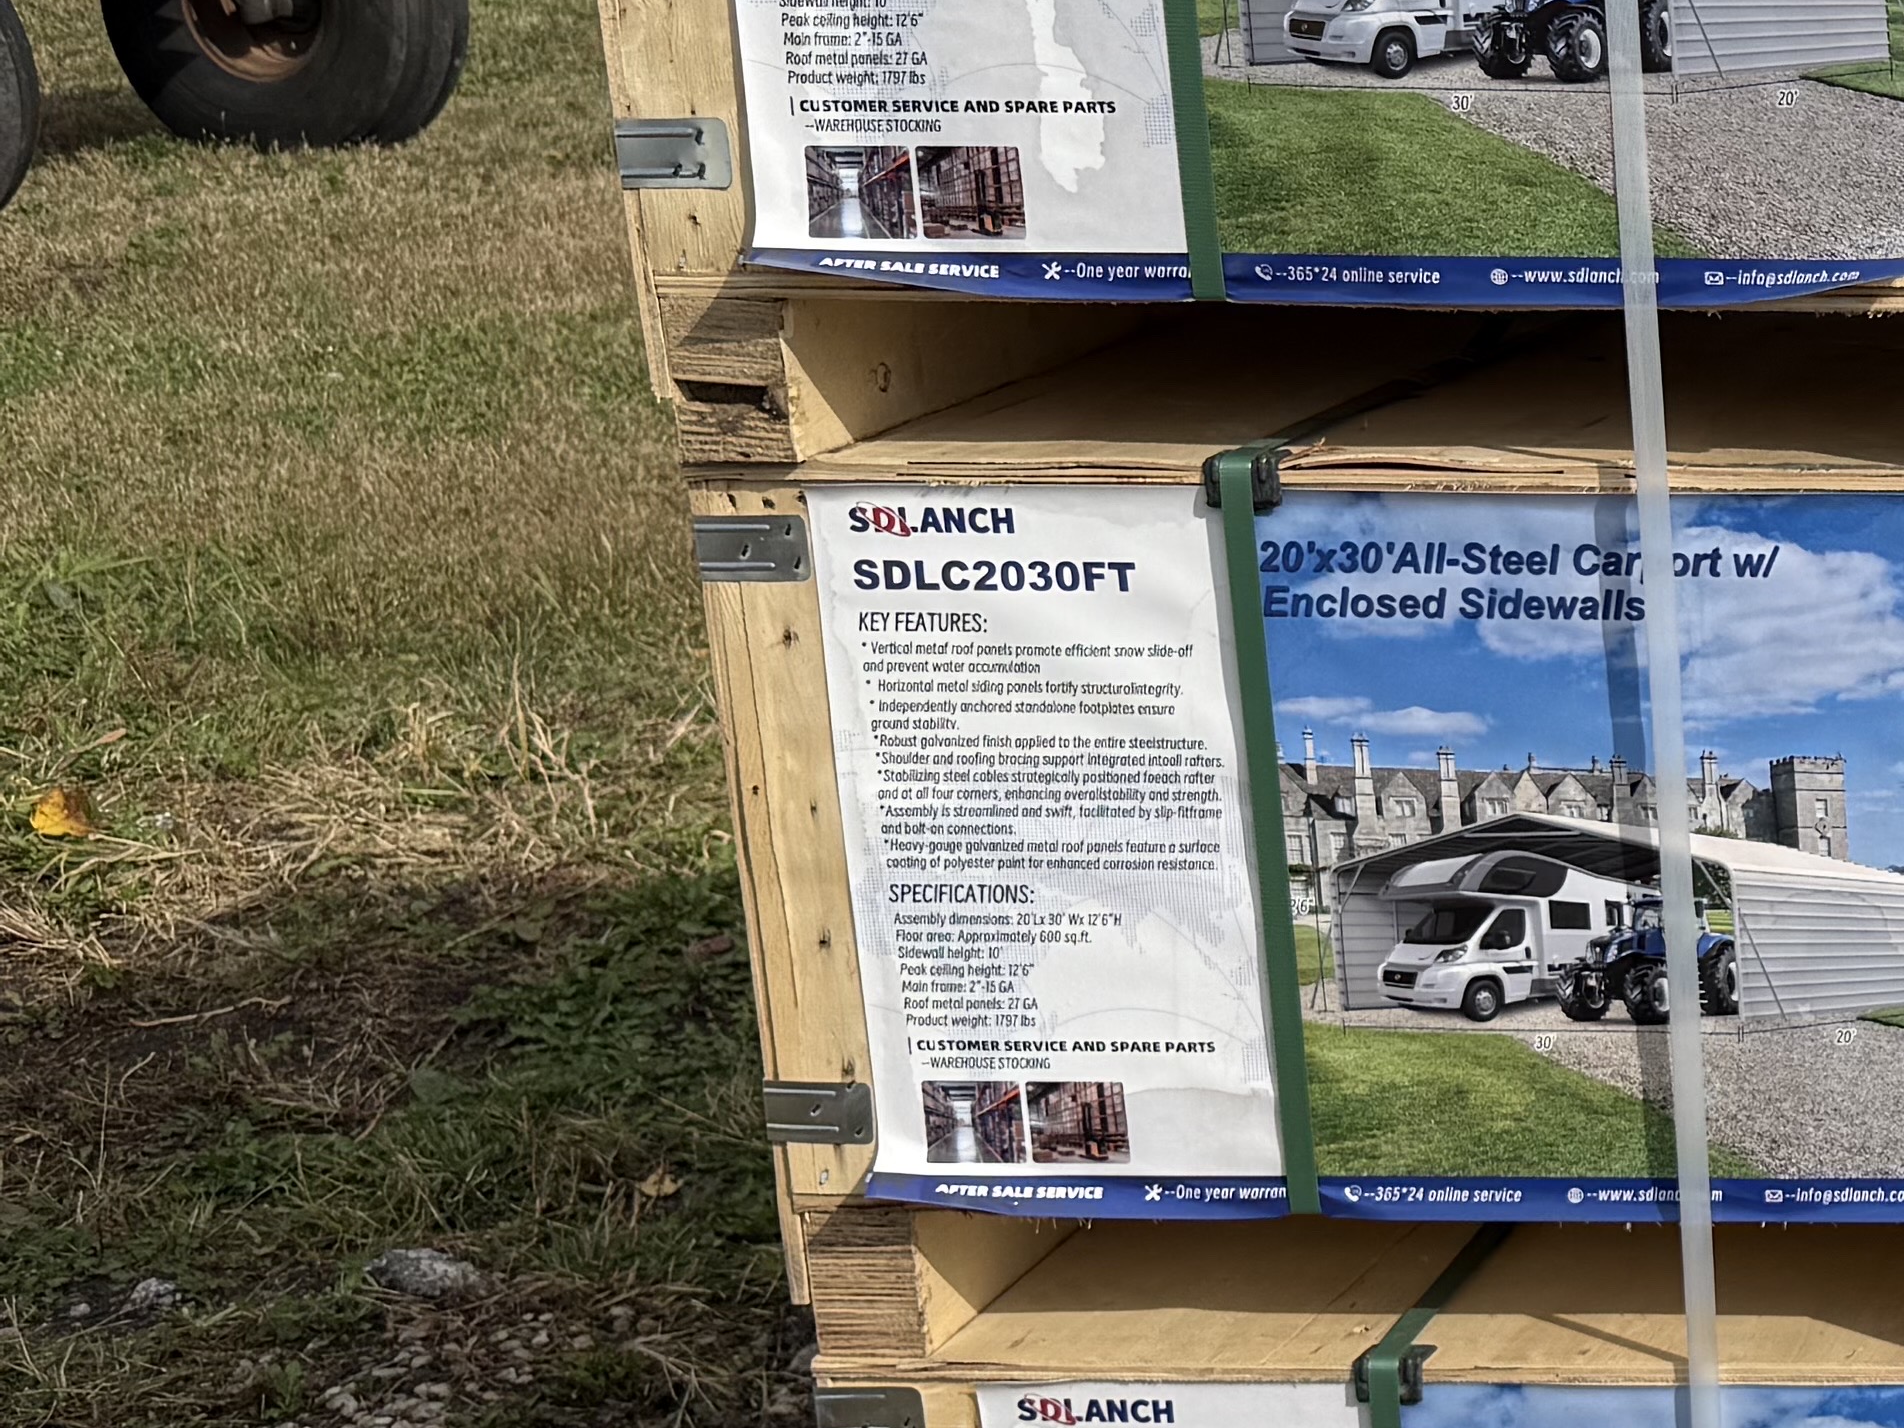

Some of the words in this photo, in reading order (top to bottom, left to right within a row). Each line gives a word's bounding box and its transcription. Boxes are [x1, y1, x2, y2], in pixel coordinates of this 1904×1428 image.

[783, 32, 811, 46] Main
[814, 32, 851, 46] frame:
[886, 33, 903, 46] GA
[787, 71, 832, 85] Product
[836, 71, 879, 87] weight:
[882, 71, 907, 85] 1797
[909, 71, 926, 85] lbs
[799, 99, 889, 113] CUSTOMER
[892, 99, 960, 113] SERVICE
[964, 100, 1000, 113] AND
[1005, 100, 1059, 114] SPARE
[1063, 100, 1117, 114] PARTS
[1450, 92, 1474, 112] 30'
[1777, 89, 1799, 108] 20'
[885, 119, 942, 133] STOCKING
[818, 256, 876, 271] AFTER
[880, 259, 925, 274] SALE
[928, 263, 1000, 279] SERVICE
[1107, 265, 1140, 282] year
[1342, 267, 1384, 283] online
[1388, 268, 1441, 284] service
[848, 502, 1015, 537] SDLANCH
[1573, 543, 1722, 584] Carort
[1733, 545, 1780, 578] w/
[853, 559, 1136, 593] SDLC2030FT
[1262, 585, 1447, 620] Enclosed
[1459, 586, 1645, 621] Sidewalls
[858, 612, 890, 632] KEY
[894, 612, 988, 633] FEATURES:
[888, 884, 1035, 906] SPECIFICATIONS:
[1533, 1033, 1556, 1050] 30'
[1836, 1027, 1857, 1044] 20'
[916, 1039, 1000, 1052] CUSTOMER
[1004, 1039, 1068, 1052] SERVICE
[1072, 1040, 1106, 1052] AND
[1110, 1040, 1161, 1053] SPARE
[1165, 1041, 1216, 1053] PARTS
[998, 1057, 1051, 1070] STOCKING
[935, 1183, 988, 1198] AFTER
[992, 1184, 1034, 1199] SALE
[1036, 1185, 1104, 1200] SERVICE
[1204, 1186, 1236, 1203] year
[1428, 1186, 1471, 1202] online
[1475, 1186, 1523, 1203] service
[1017, 1394, 1175, 1425] SDLANCH
